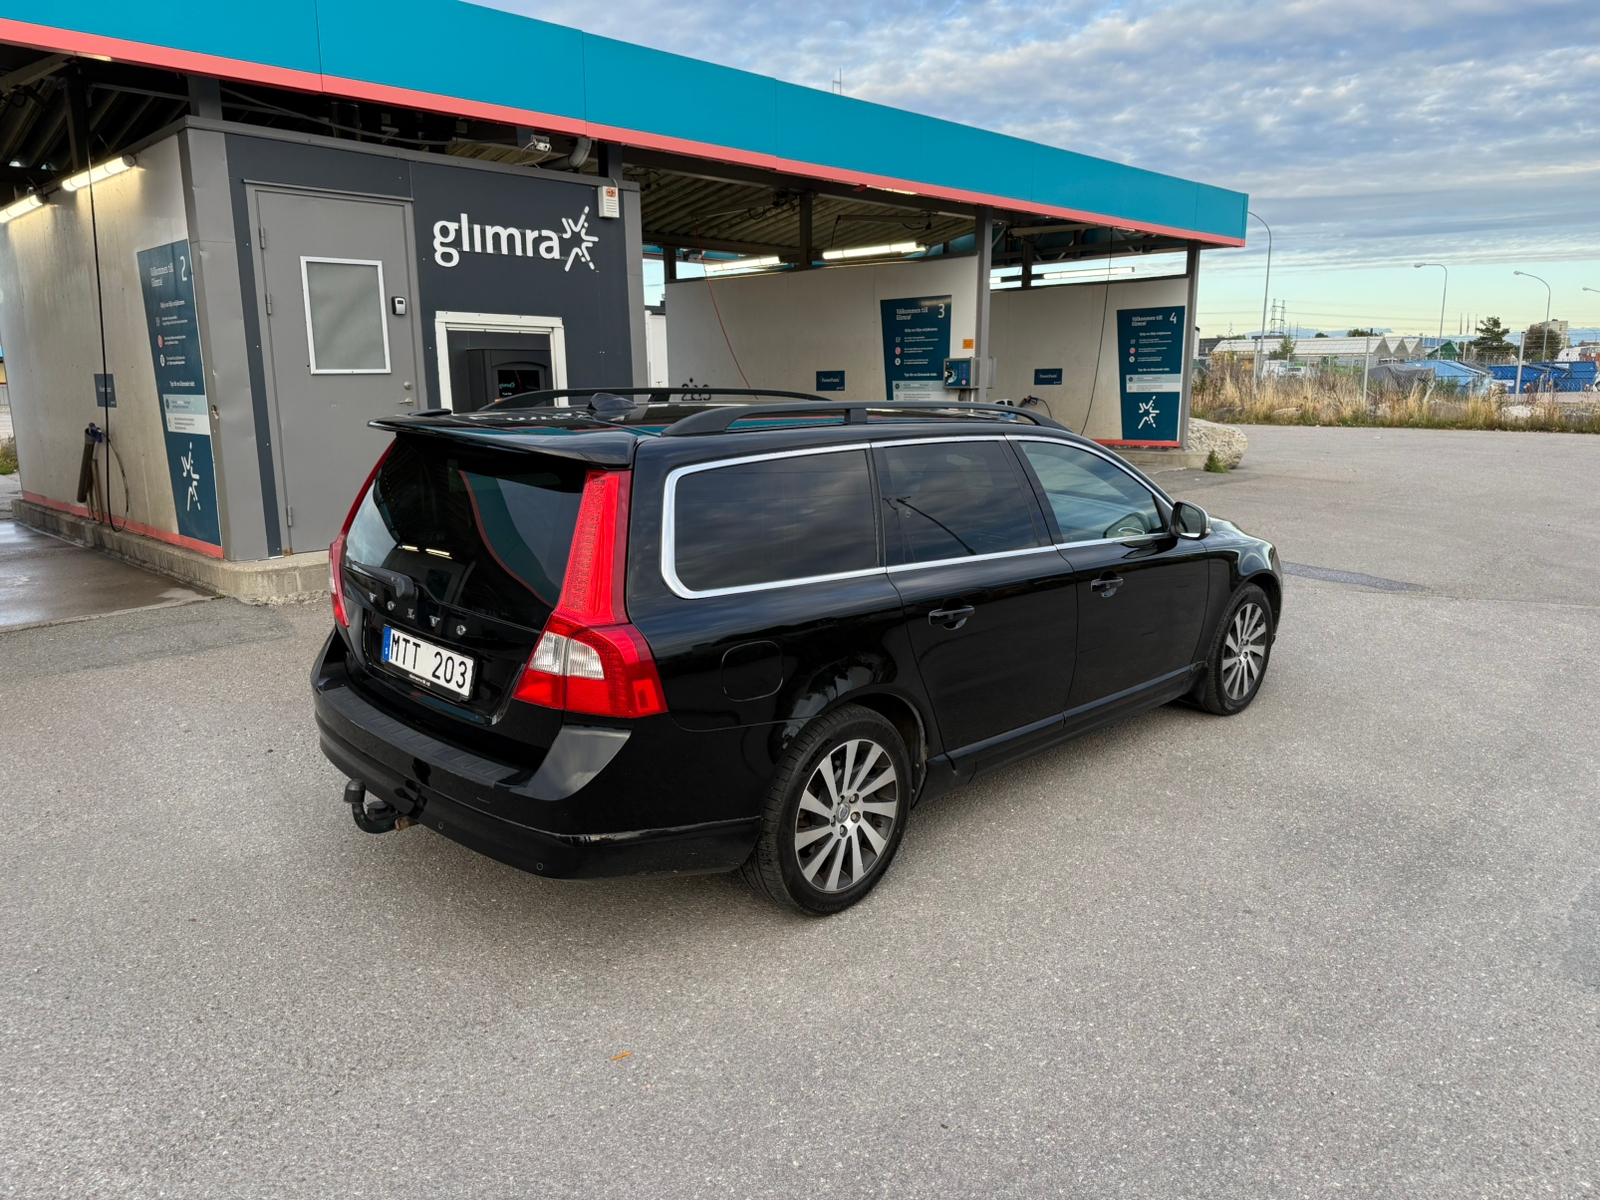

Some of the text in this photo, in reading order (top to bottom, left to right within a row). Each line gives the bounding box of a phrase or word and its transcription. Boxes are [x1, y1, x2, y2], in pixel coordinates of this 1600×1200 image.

[433, 213, 561, 267] glimra
[180, 255, 188, 281] 2
[938, 303, 945, 318] 3
[1169, 312, 1177, 324] 4
[369, 592, 466, 636] VOLVO
[391, 634, 467, 689] MTT 203
